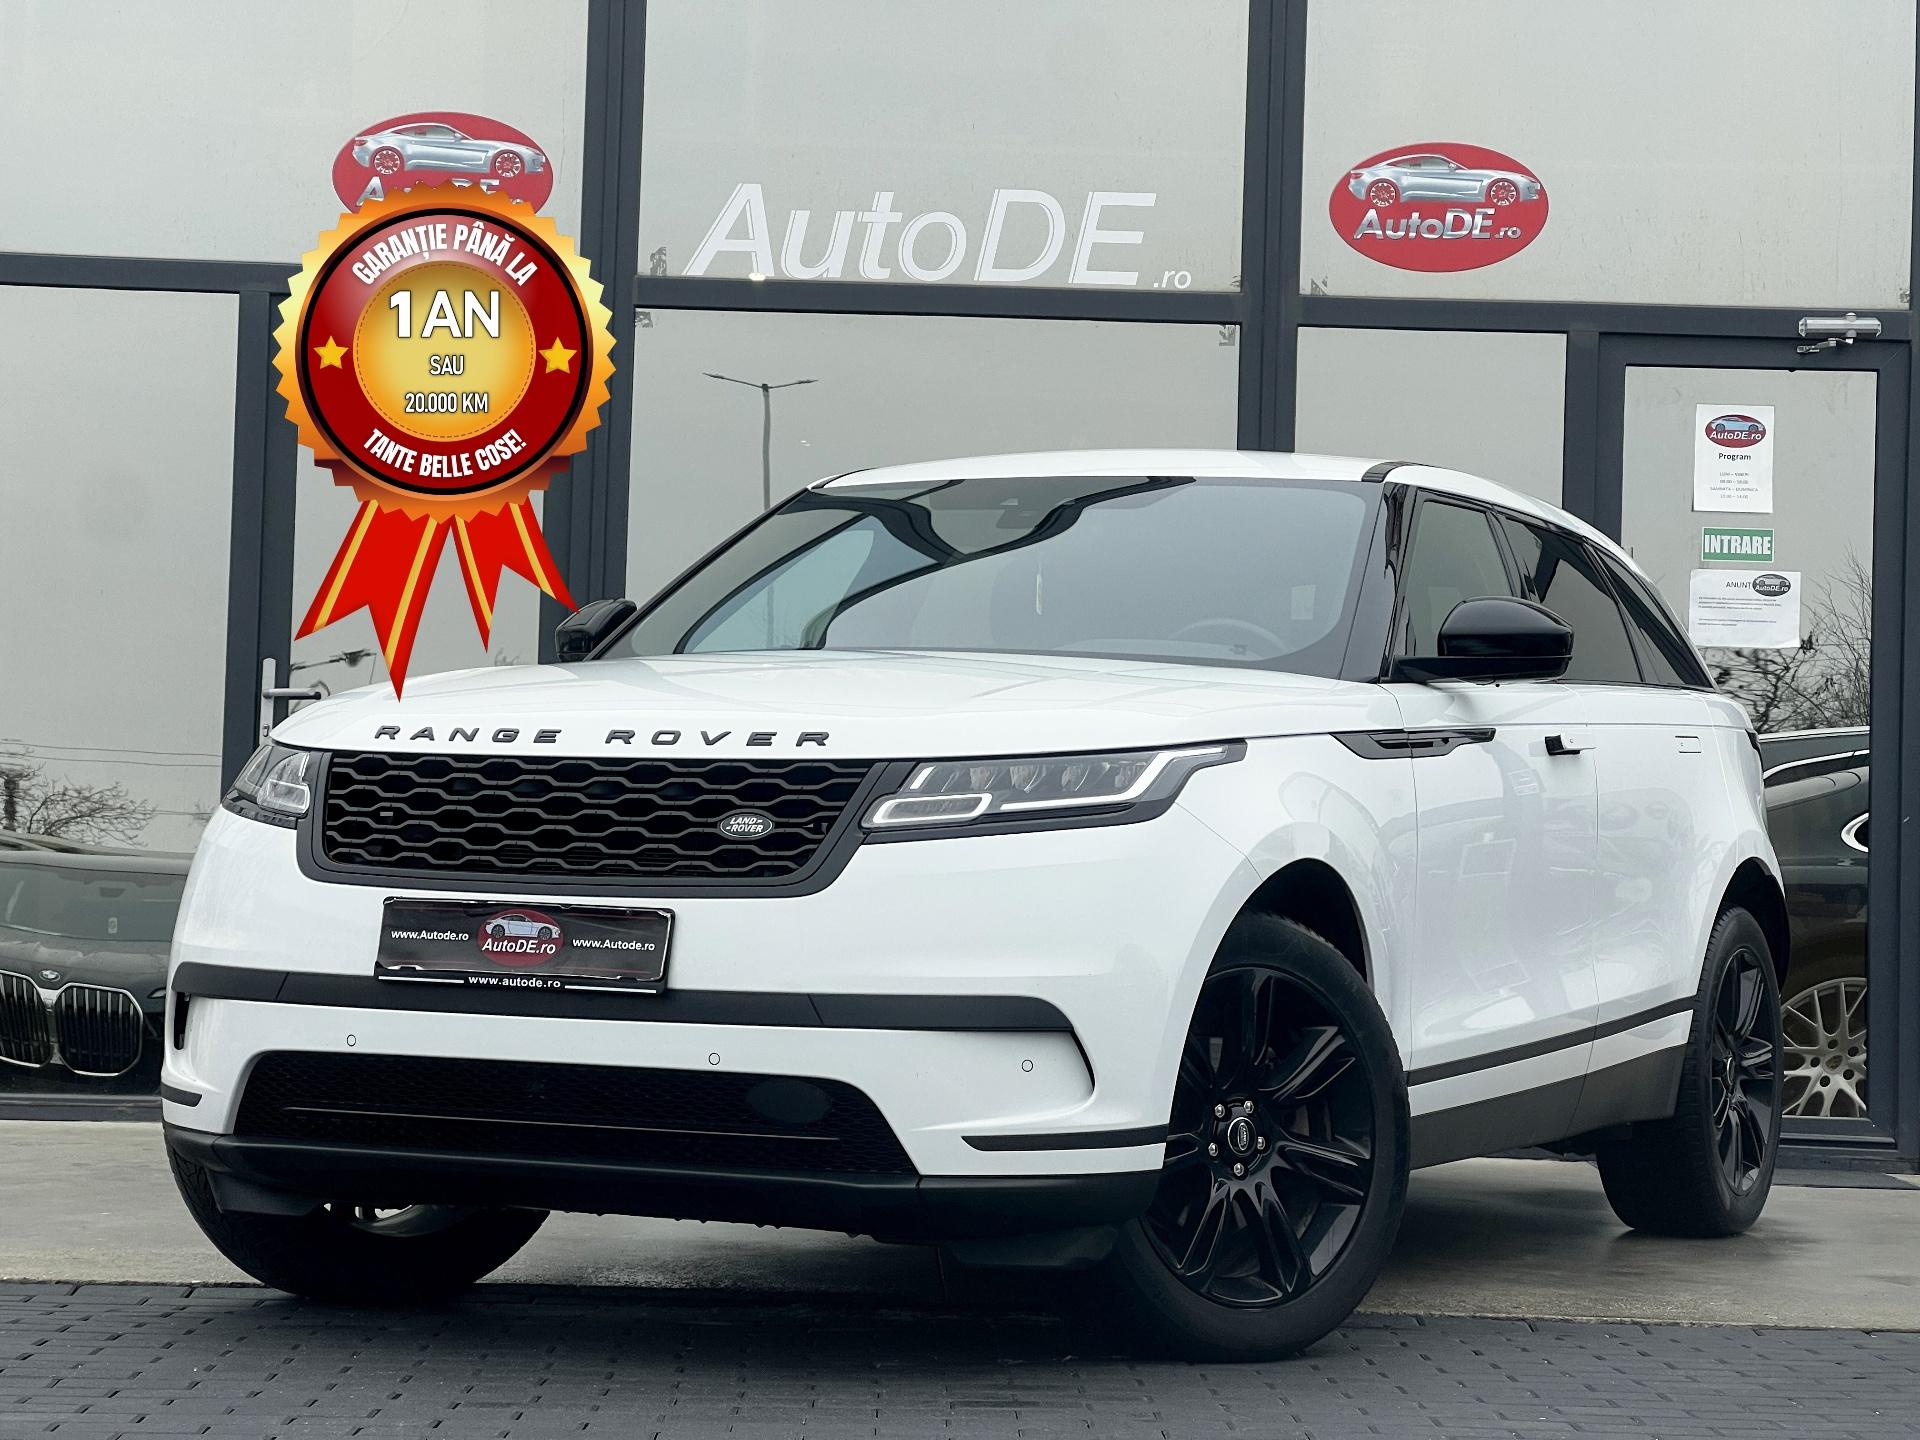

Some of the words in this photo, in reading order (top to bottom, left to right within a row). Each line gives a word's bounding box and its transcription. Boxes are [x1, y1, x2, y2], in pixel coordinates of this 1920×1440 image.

[1709, 431, 1762, 440] AutoDE.ro
[1718, 452, 1751, 462] Program
[1704, 534, 1771, 555] INTRARE
[374, 725, 562, 744] RANGE
[605, 729, 830, 748] ROVER
[729, 816, 757, 825] LAND
[730, 824, 763, 832] ROVER
[391, 929, 469, 942] www.Autode.ro
[482, 937, 556, 955] AutoDE.ro
[572, 938, 655, 952] www.Autode.ro
[468, 975, 561, 989] www.autode.ro
